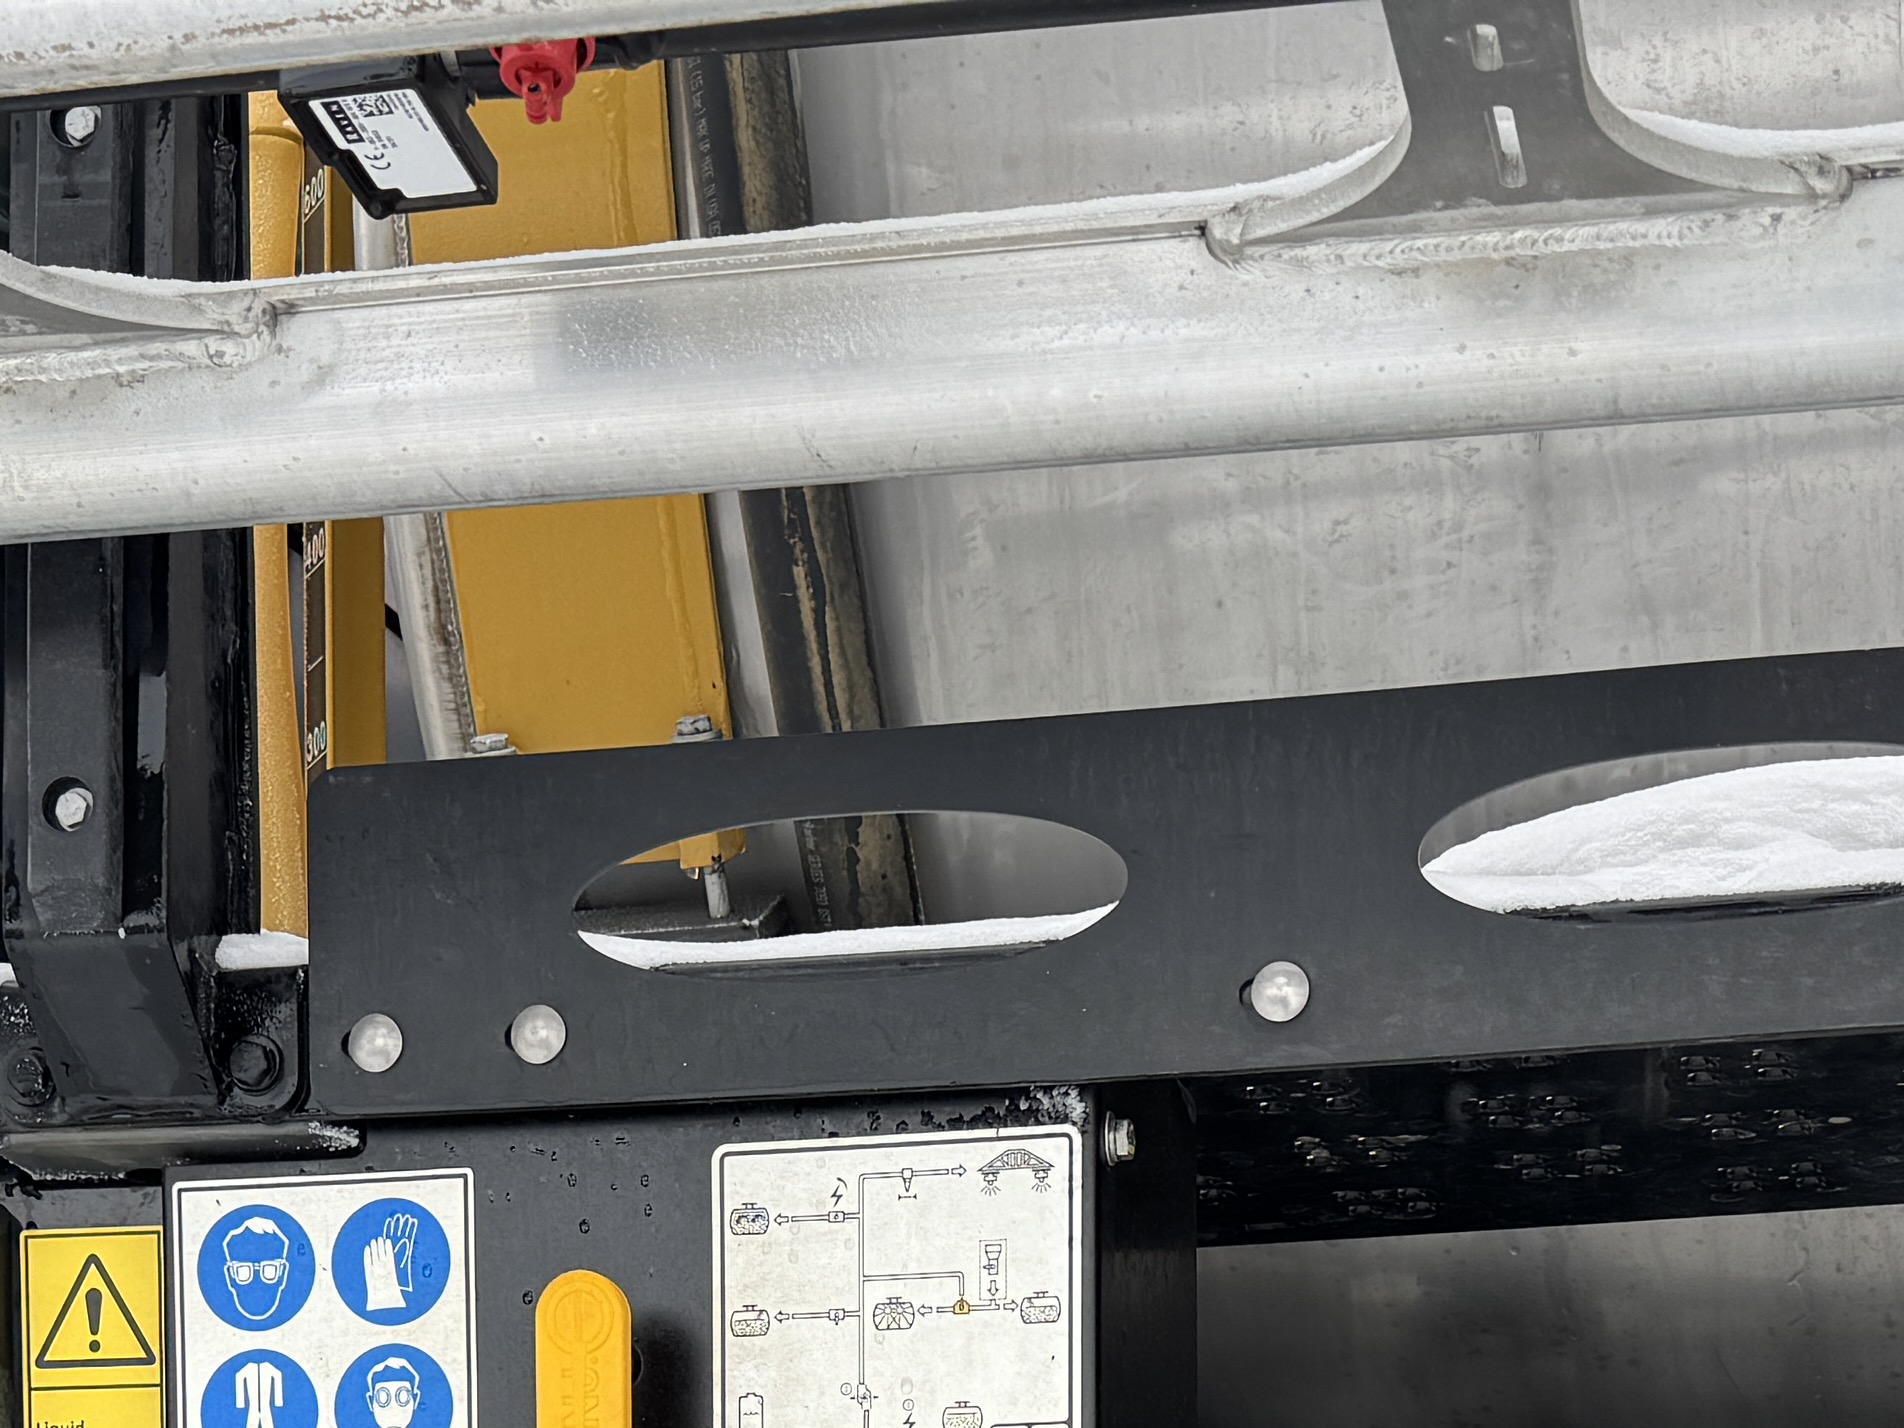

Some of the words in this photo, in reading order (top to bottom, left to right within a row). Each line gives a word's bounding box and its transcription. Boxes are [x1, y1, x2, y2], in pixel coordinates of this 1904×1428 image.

[329, 103, 360, 141] RAVEN
[304, 168, 324, 214] 600
[304, 527, 325, 570] 400
[305, 720, 326, 763] 300
